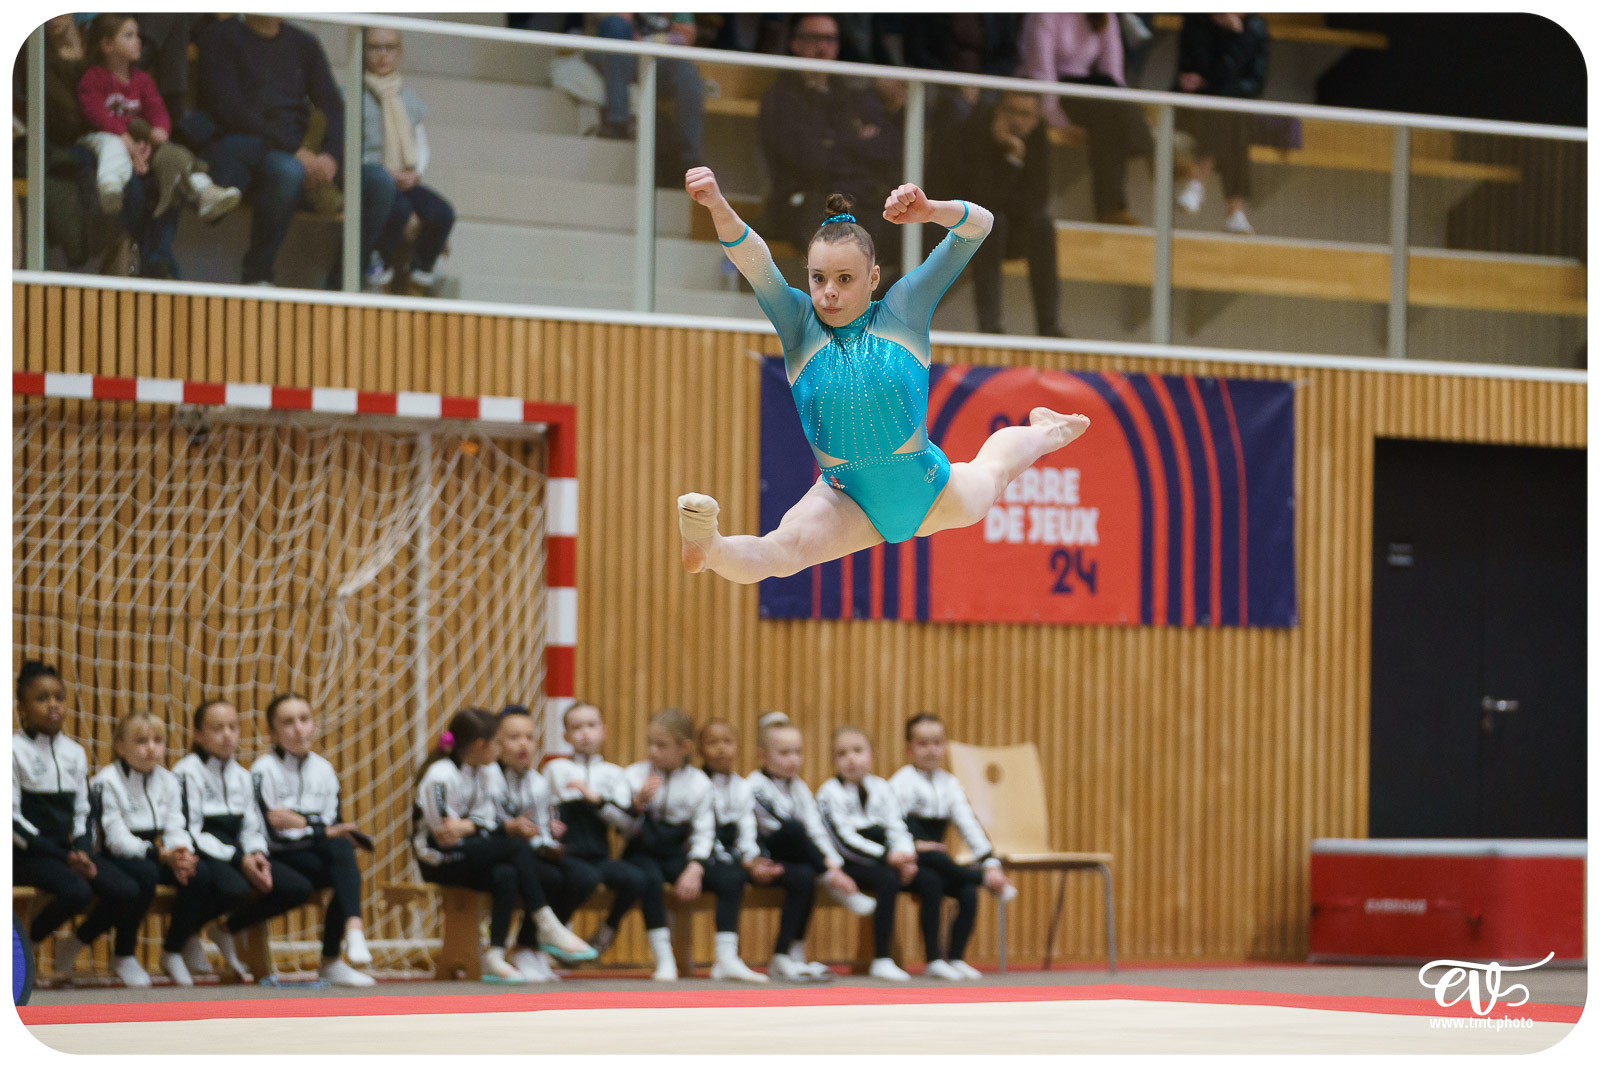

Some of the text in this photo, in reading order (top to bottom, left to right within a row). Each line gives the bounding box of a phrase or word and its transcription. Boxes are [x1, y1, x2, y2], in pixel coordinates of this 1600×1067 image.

[1003, 467, 1081, 505] ERRE
[985, 506, 1100, 547] DE JEUX
[1050, 549, 1097, 595] 24
